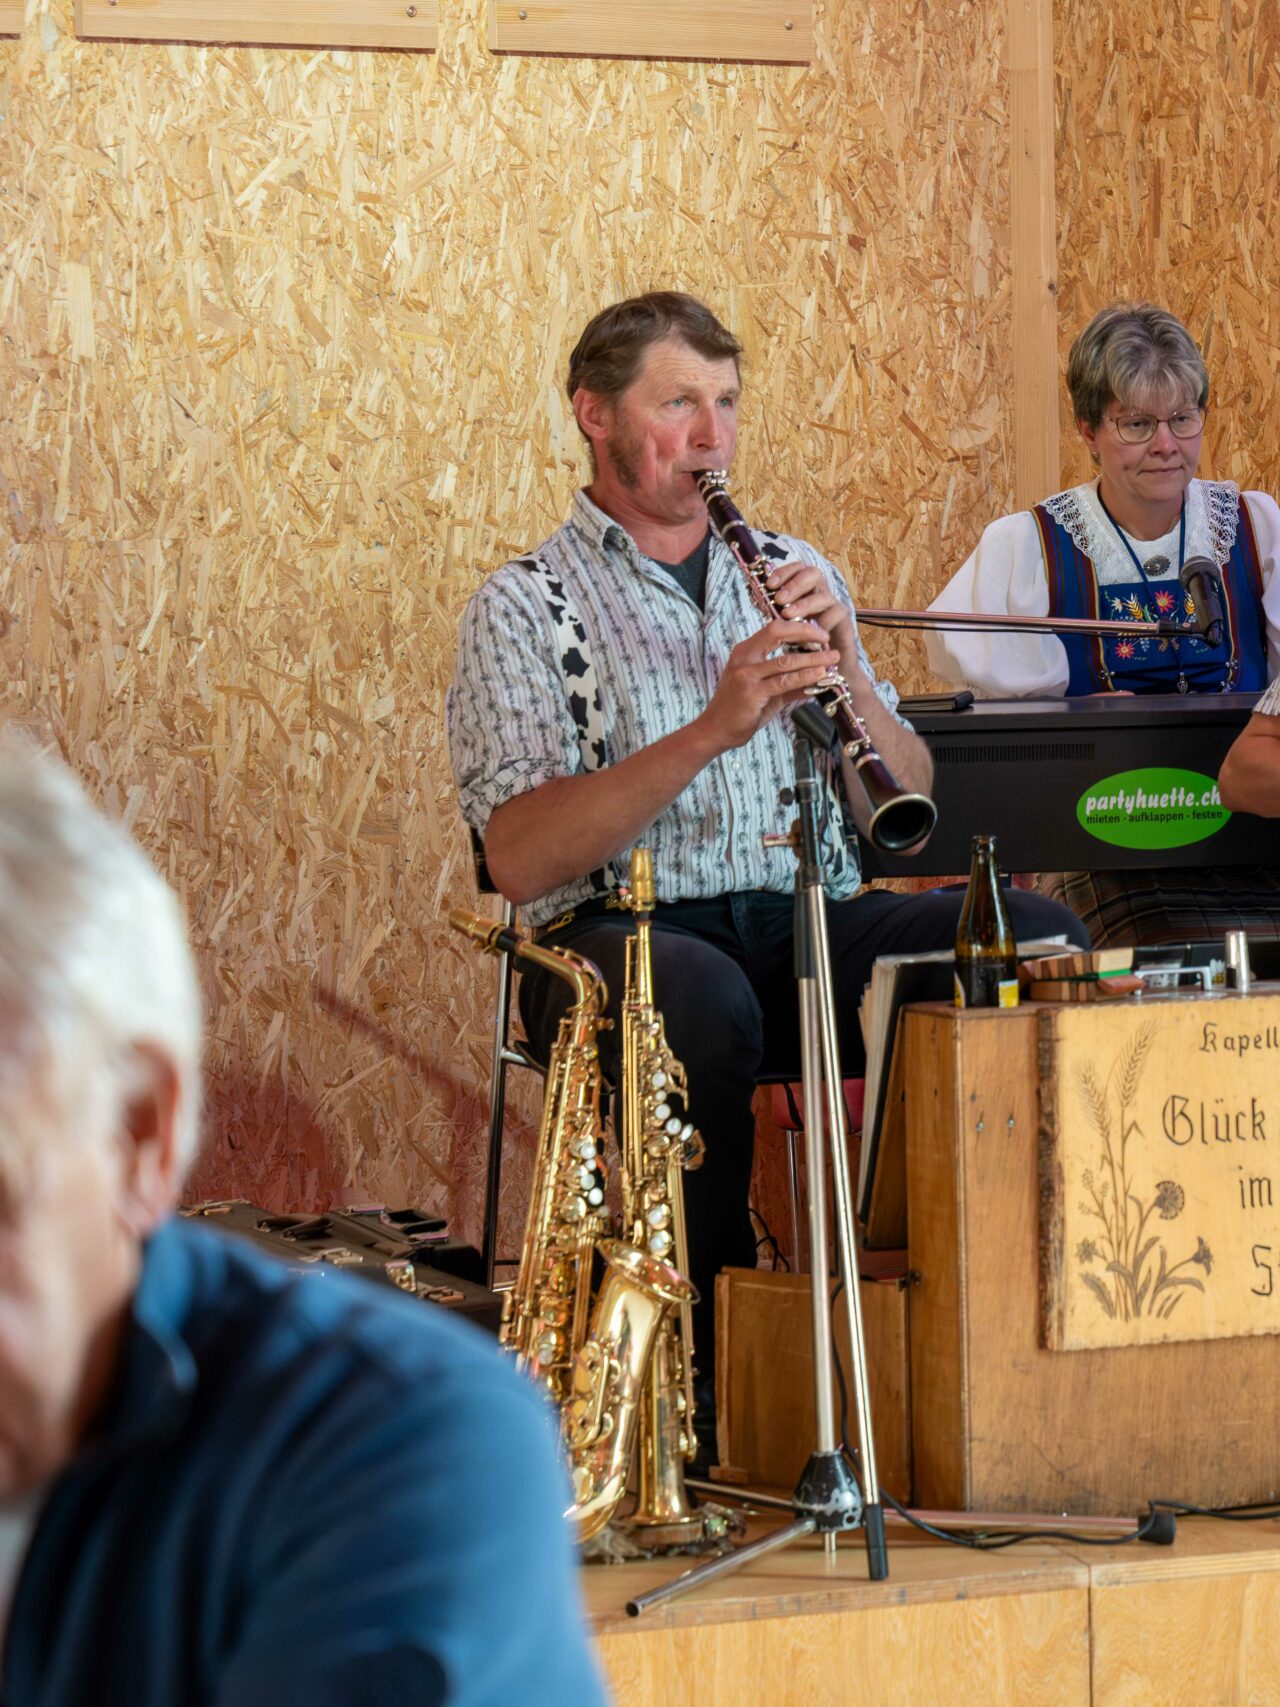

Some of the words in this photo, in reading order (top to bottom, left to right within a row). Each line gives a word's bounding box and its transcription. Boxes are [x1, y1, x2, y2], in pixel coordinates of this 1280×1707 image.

[1085, 785, 1221, 816] partyhuette.ch
[1086, 813, 1120, 825] mieten
[1128, 811, 1184, 823] aufklappen
[1192, 810, 1223, 819] festen
[1161, 1094, 1267, 1146] Glück
[1237, 1164, 1273, 1210] im
